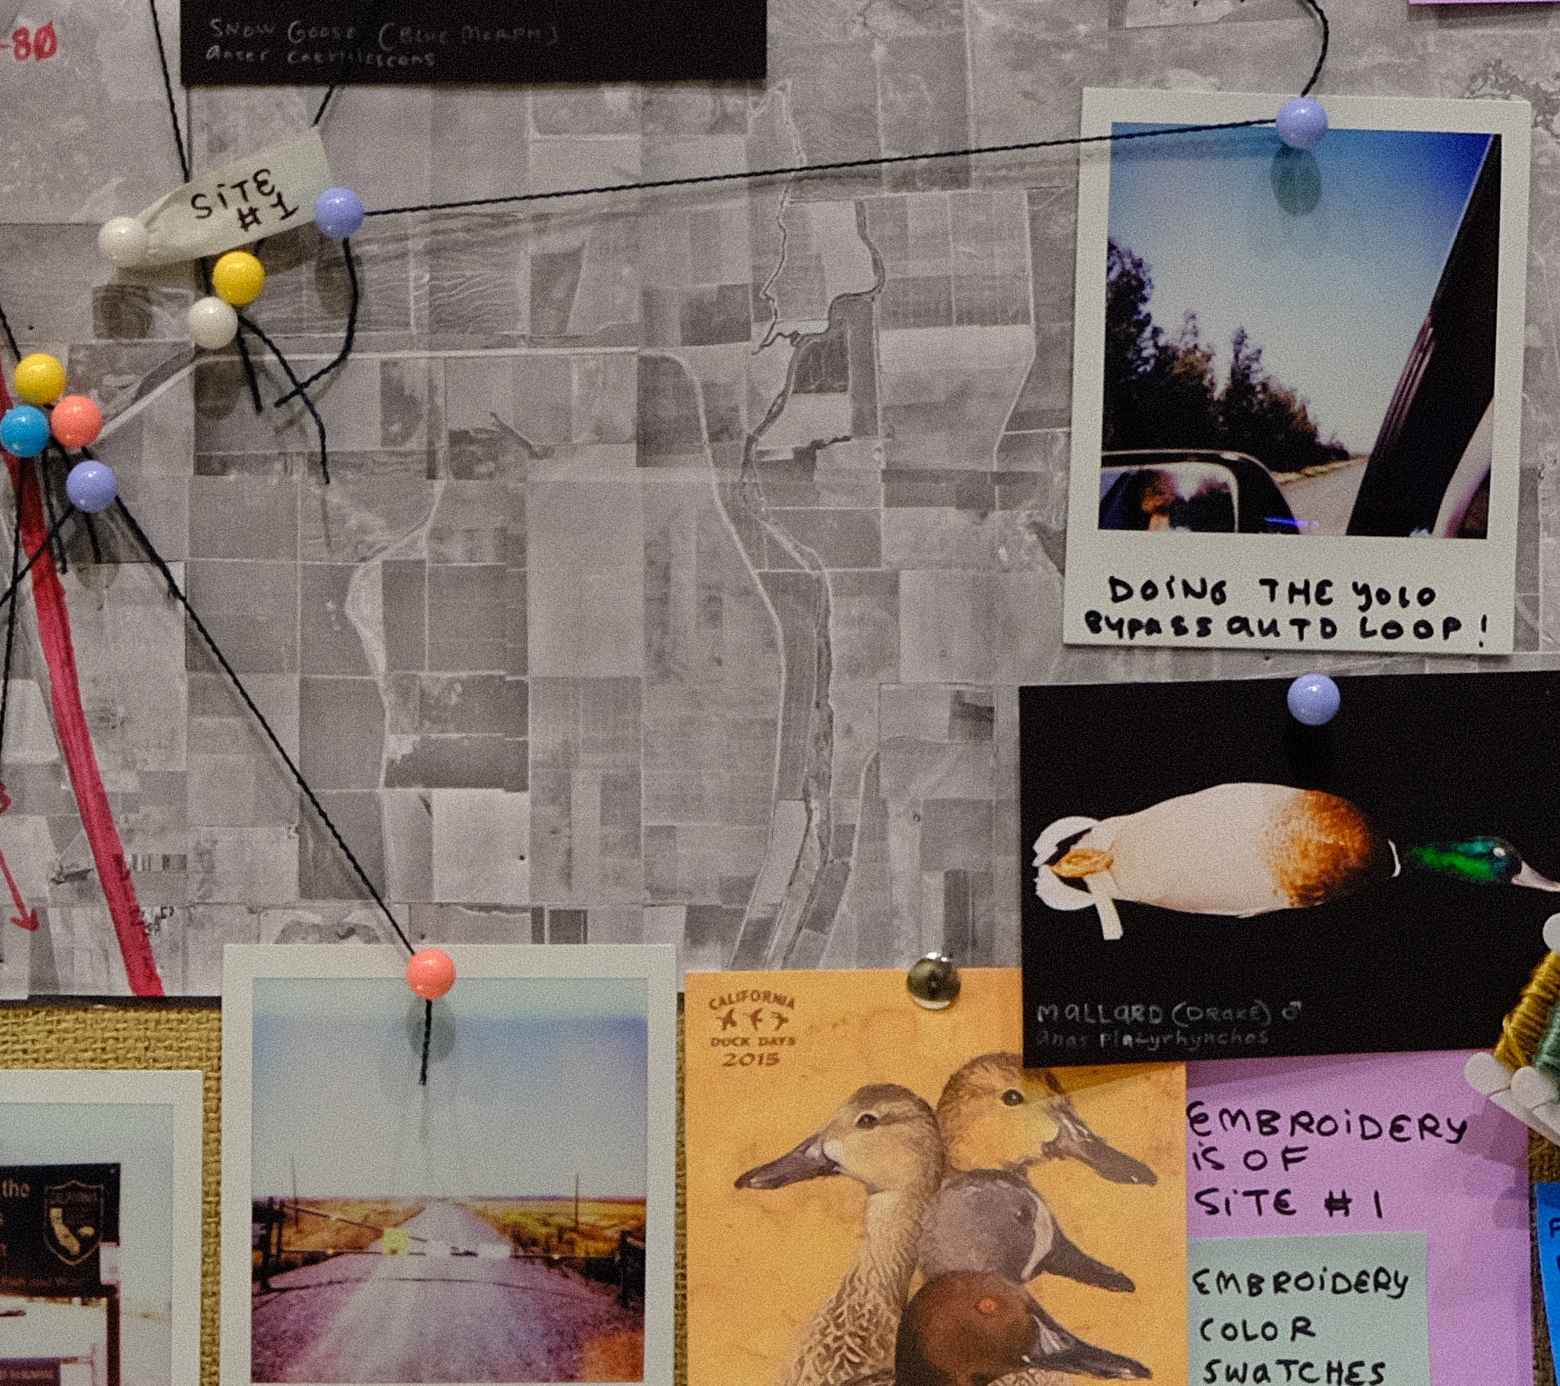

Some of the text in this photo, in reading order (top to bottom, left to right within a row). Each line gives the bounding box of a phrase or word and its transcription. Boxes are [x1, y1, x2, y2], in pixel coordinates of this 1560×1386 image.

[1260, 577, 1334, 605] THE
[1359, 616, 1488, 647] LOOP!
[708, 990, 796, 1011] CALIFORNIA
[710, 1036, 796, 1047] DUCK DAYS
[722, 1053, 780, 1067] 2015
[2, 1179, 30, 1198] the
[1200, 1317, 1315, 1342] COLOR
